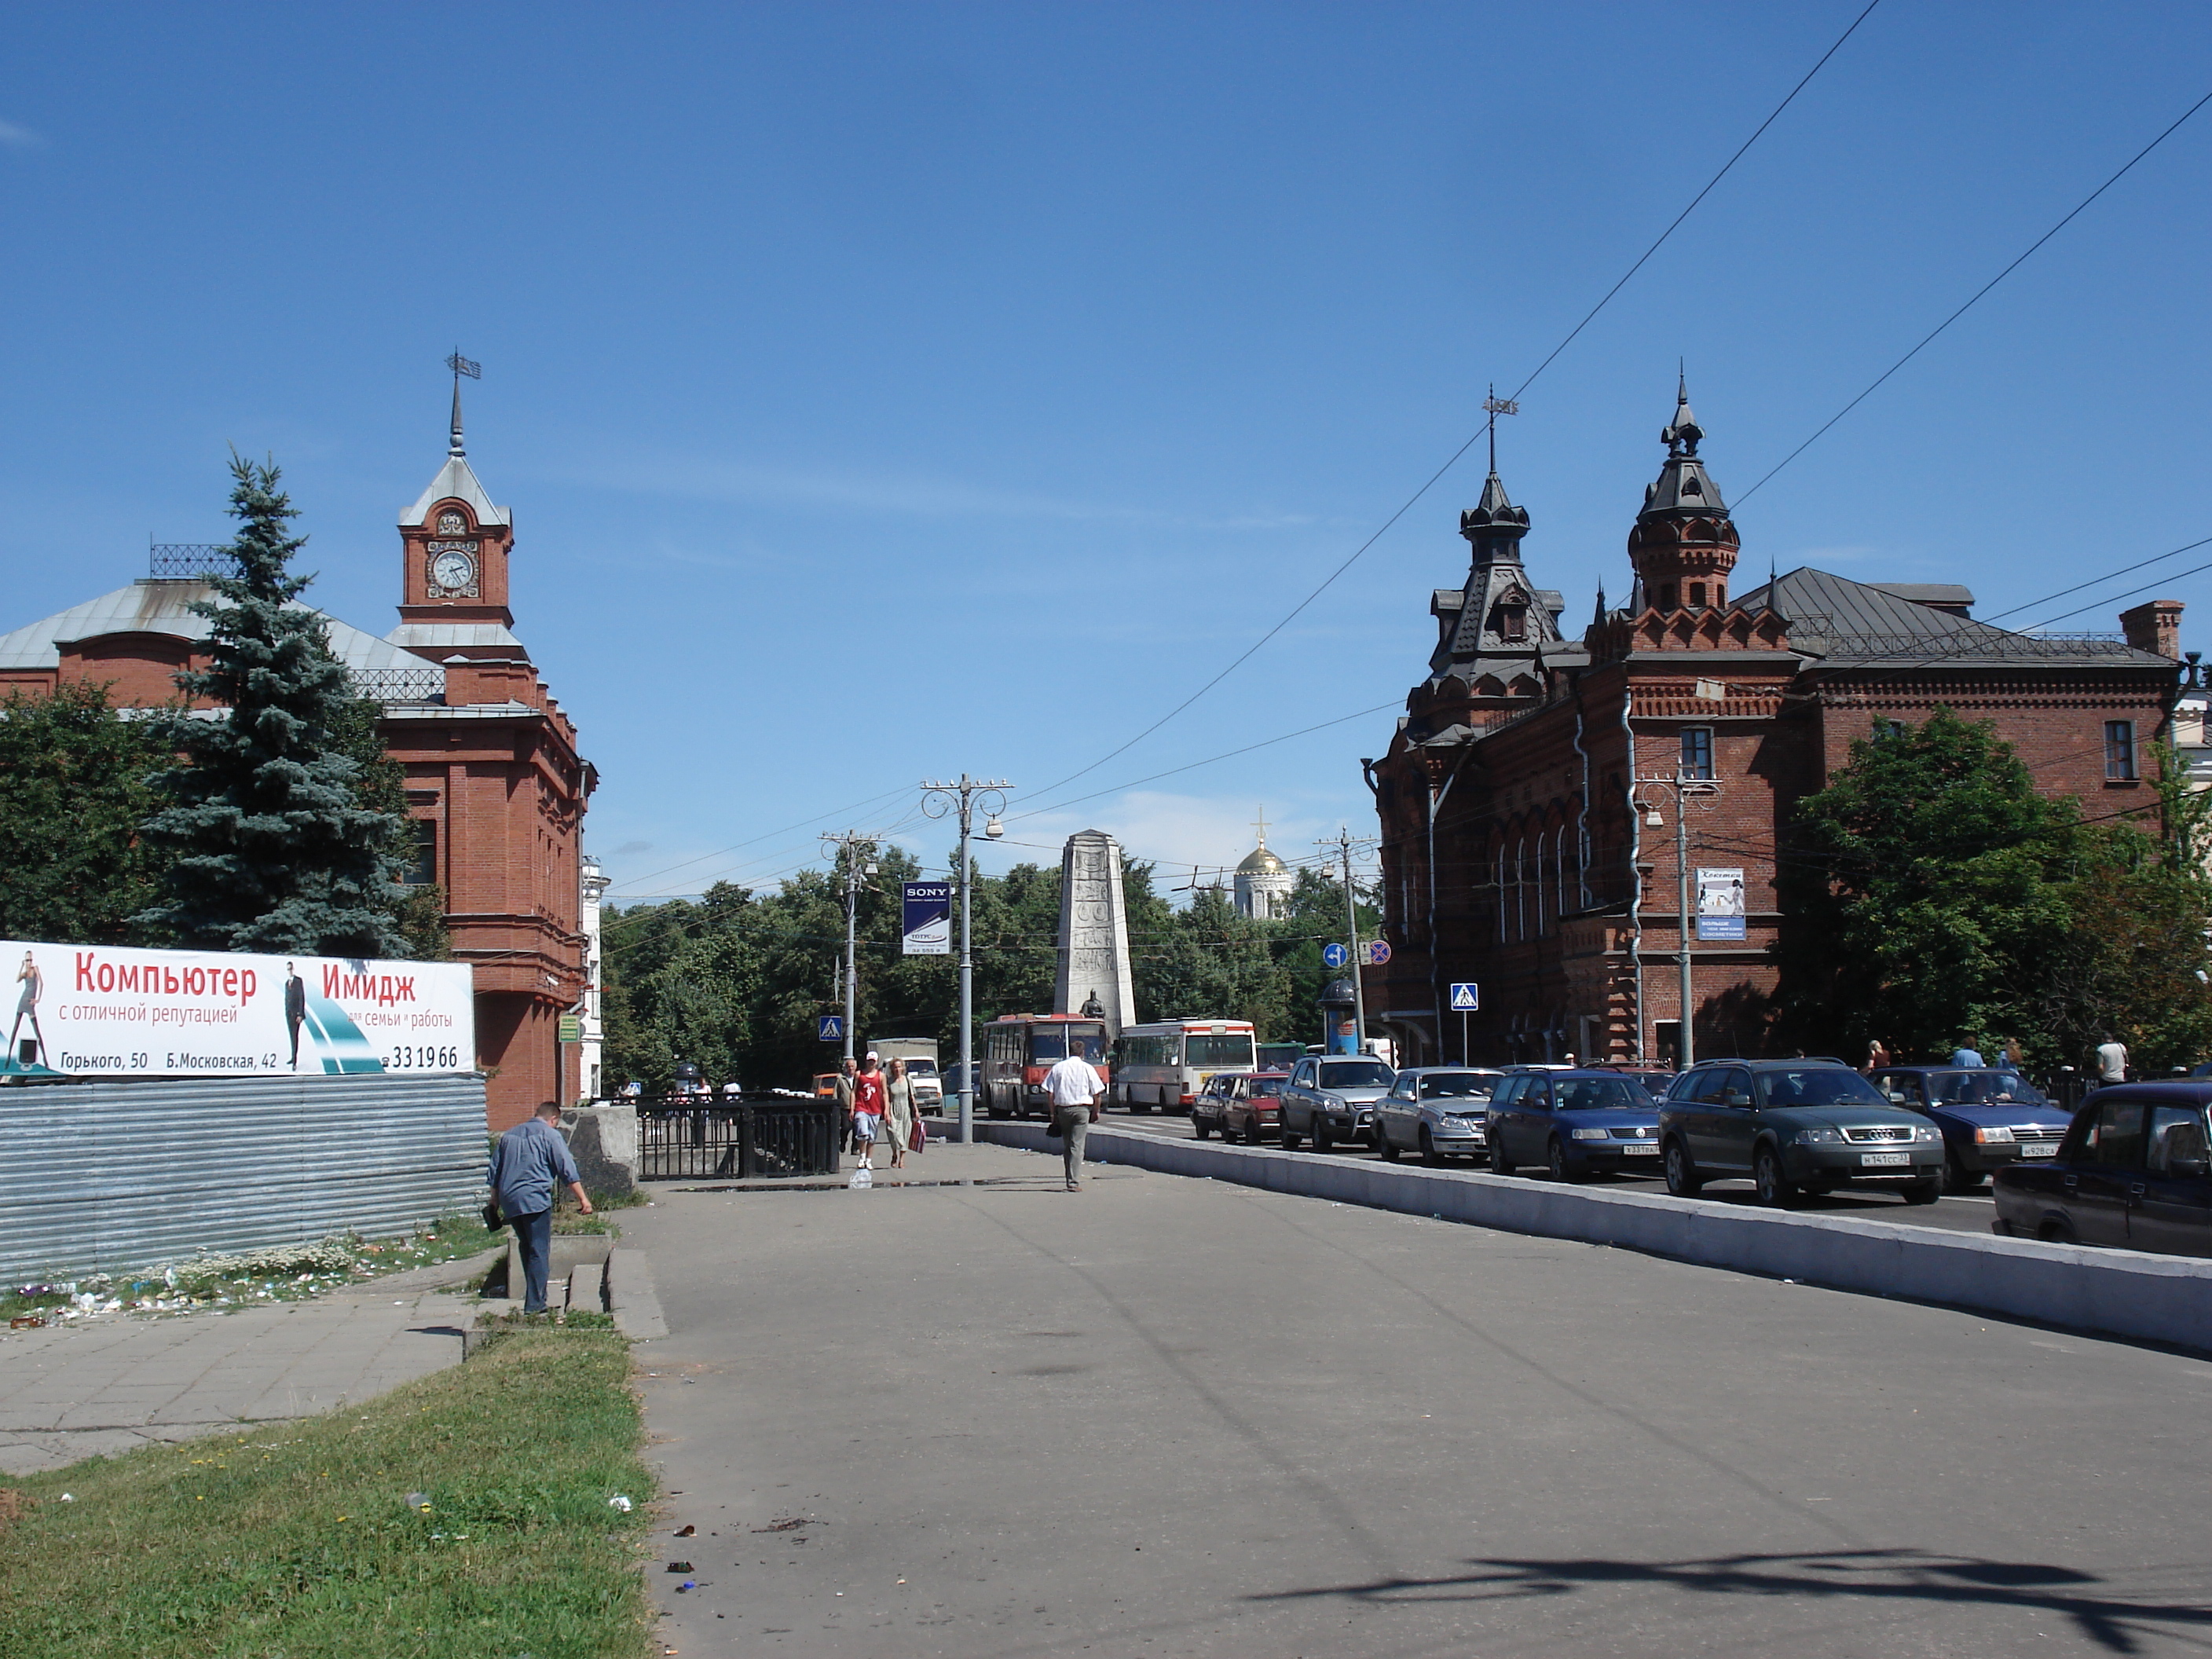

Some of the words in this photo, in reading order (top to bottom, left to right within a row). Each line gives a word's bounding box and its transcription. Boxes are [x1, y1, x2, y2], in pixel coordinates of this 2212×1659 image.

[76, 953, 257, 1007] Компьютер
[323, 964, 416, 1007] Имидж
[59, 1005, 68, 1020] с
[72, 1002, 146, 1021] отличной
[152, 1004, 238, 1027] репутацией
[348, 1012, 362, 1022] для
[364, 1012, 401, 1027] семьи
[412, 1009, 452, 1031] работы
[60, 1052, 125, 1071] Горького,
[131, 1053, 148, 1068] 50
[262, 1053, 276, 1068] 42
